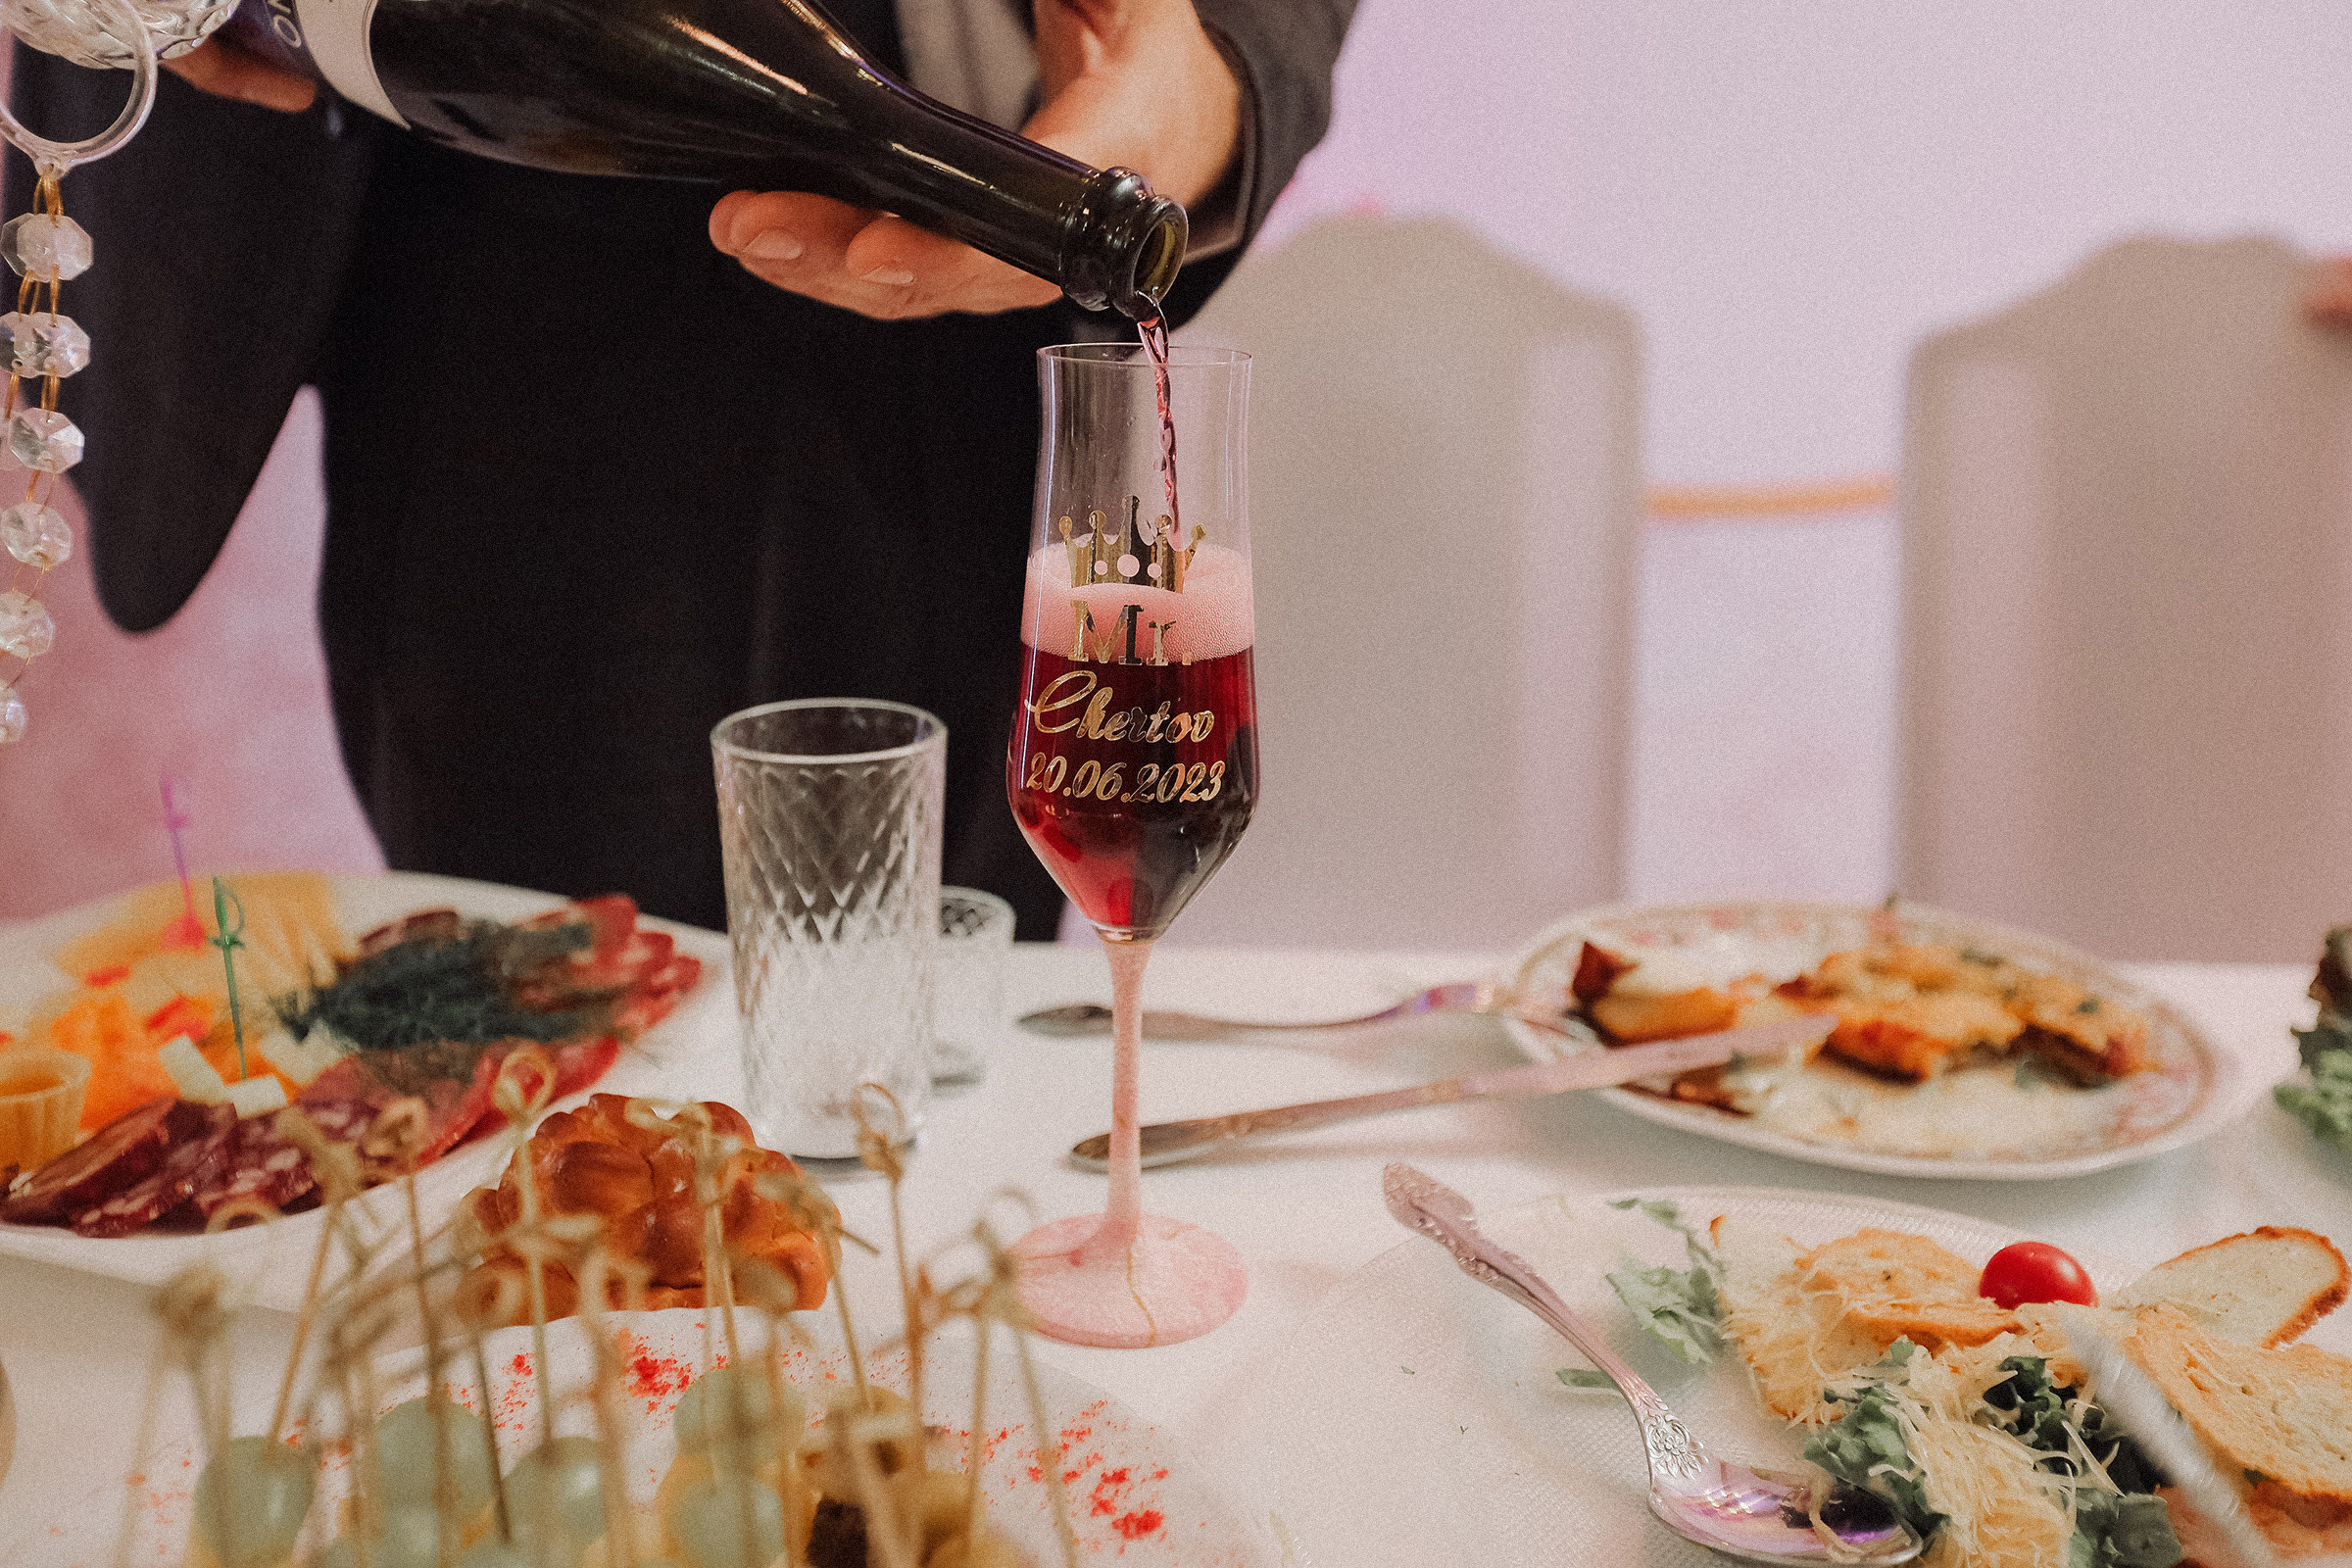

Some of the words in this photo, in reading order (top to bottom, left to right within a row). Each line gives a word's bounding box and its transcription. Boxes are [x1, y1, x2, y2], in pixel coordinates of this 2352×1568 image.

[1068, 600, 1192, 666] Mr.
[1024, 670, 1215, 743] Chertov
[1026, 753, 1226, 804] 20.06.2023
